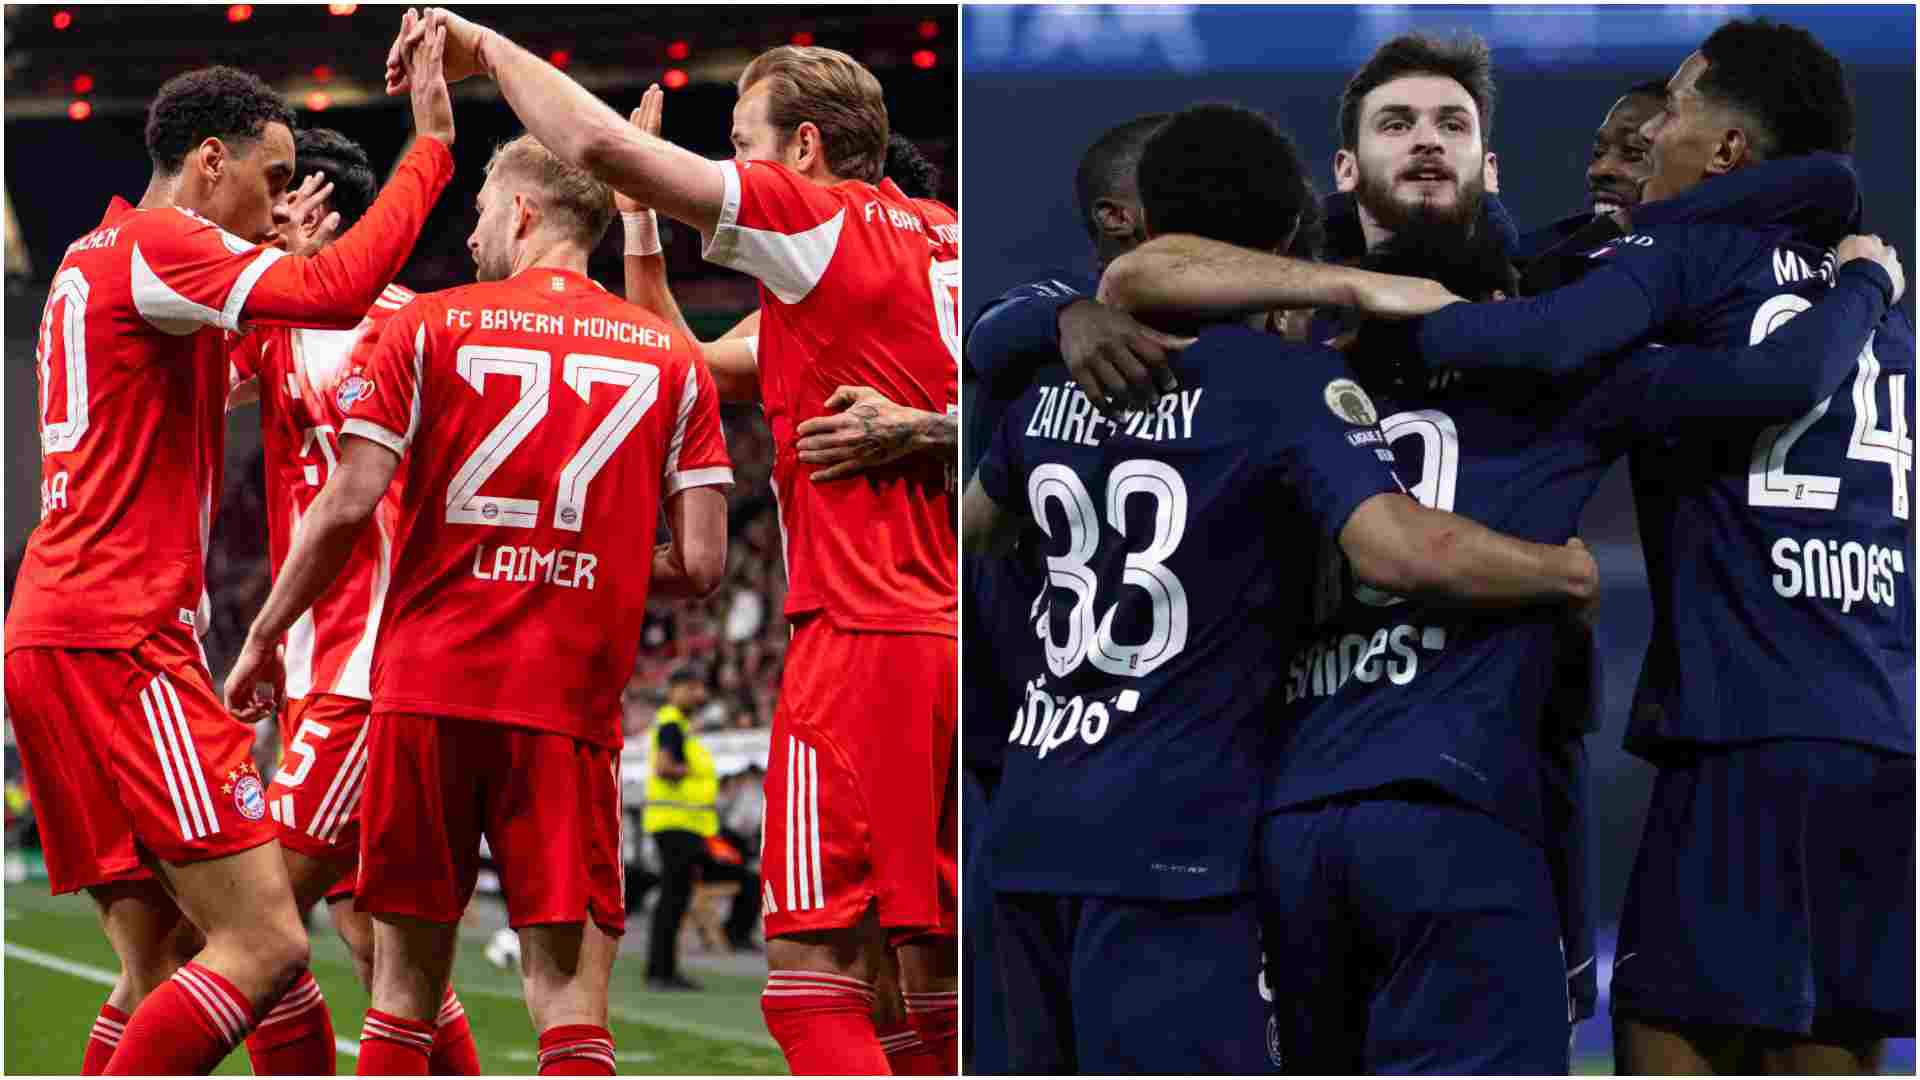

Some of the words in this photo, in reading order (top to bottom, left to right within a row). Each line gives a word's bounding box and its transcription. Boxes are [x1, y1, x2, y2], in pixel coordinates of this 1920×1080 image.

[446, 308, 472, 329] FC
[480, 309, 563, 336] BAYERN
[572, 316, 671, 350] MÜNCHEN
[445, 344, 660, 532] 27
[472, 543, 598, 590] LAIMER
[1028, 458, 1189, 677] 33
[1770, 537, 1895, 613] snipes
[274, 719, 331, 788] 5
